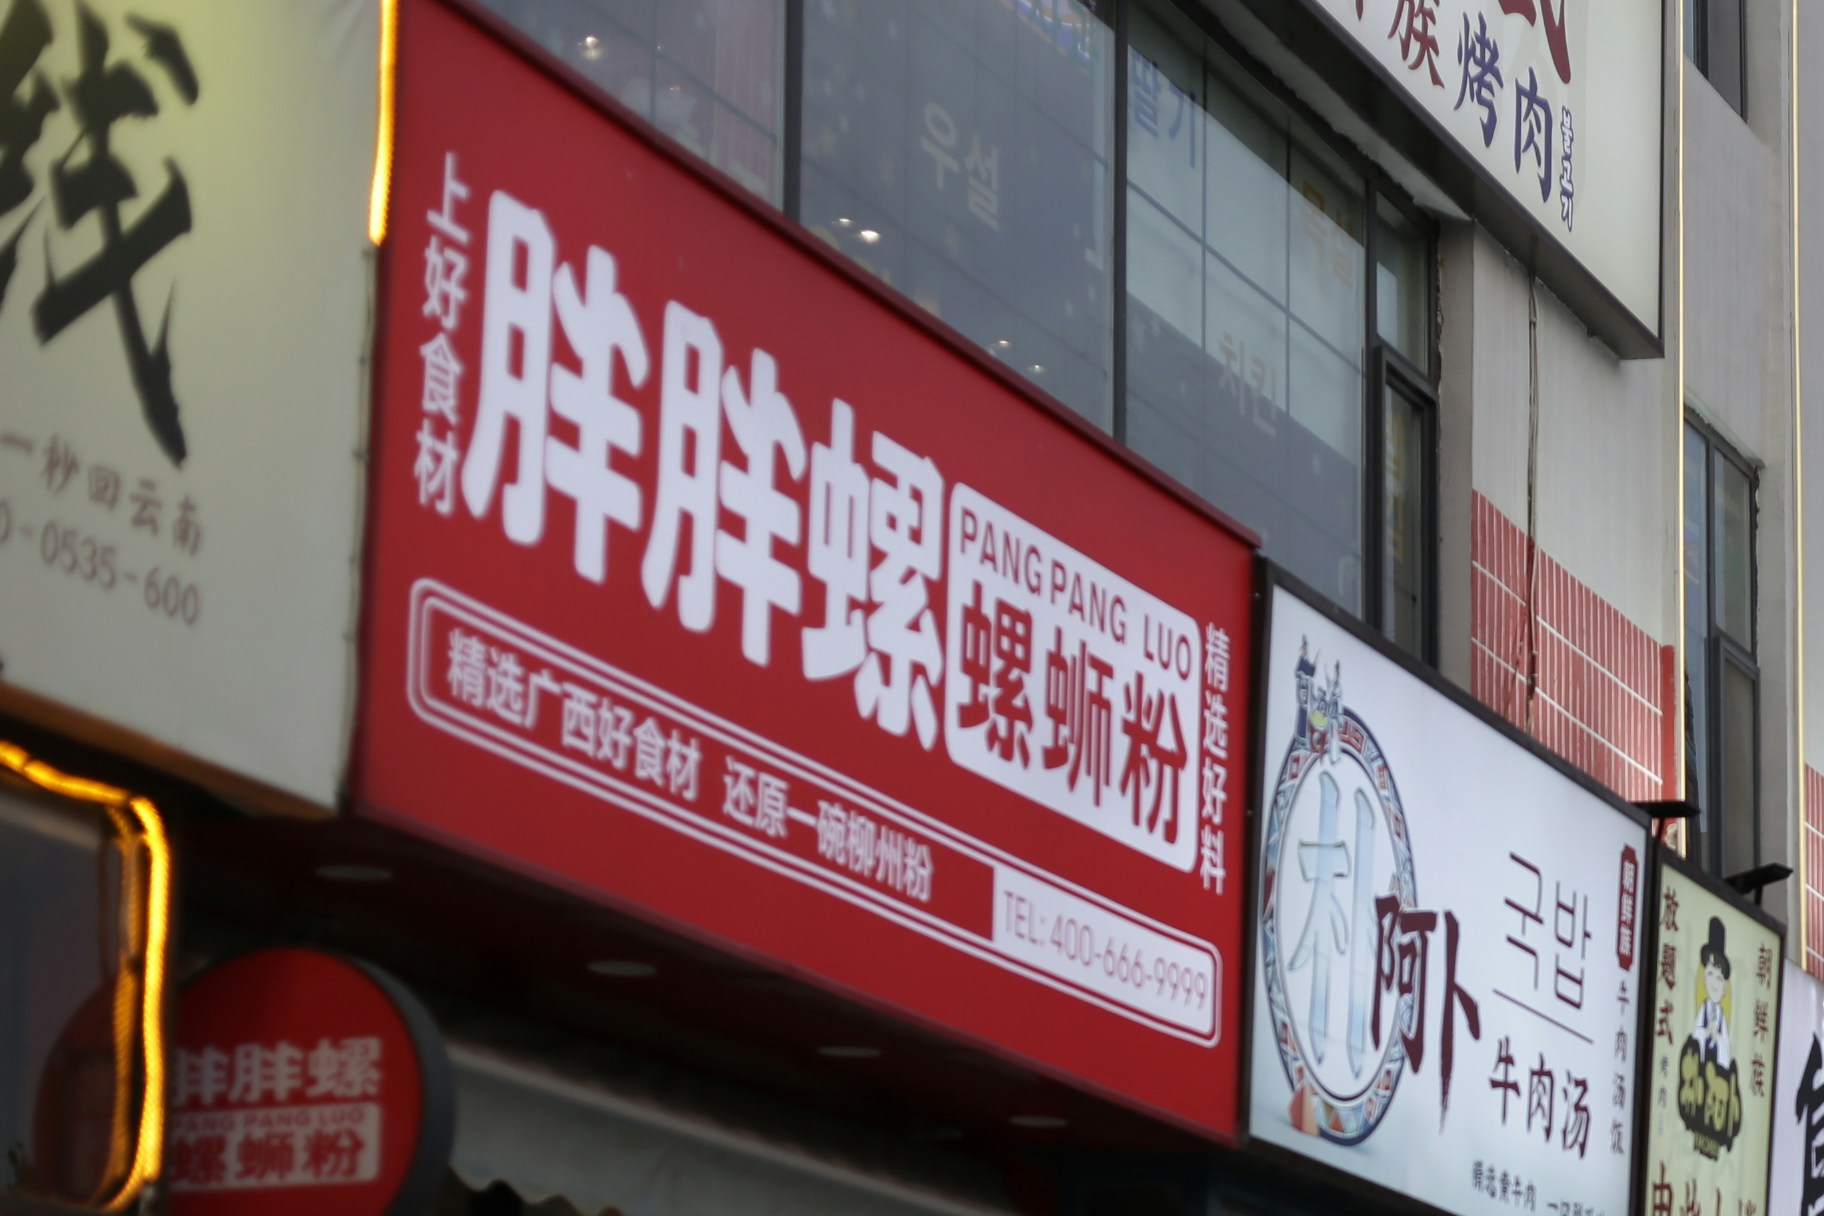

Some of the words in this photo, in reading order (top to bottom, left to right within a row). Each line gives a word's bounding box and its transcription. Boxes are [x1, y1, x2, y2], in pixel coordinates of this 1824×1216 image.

[920, 102, 1000, 231] 우설
[1560, 104, 1574, 233] 불고기
[414, 152, 471, 516] 上好食材
[461, 188, 945, 752] 胖胖螺
[960, 504, 1044, 598] PANG
[1051, 557, 1127, 646] PANG
[1143, 618, 1192, 684] LUO
[446, 628, 702, 800] 精选广西好食材
[722, 756, 933, 904] 还原一碗柳州粉
[957, 592, 1188, 846] 螺蛳粉
[1199, 622, 1231, 897] 精选好料
[1503, 850, 1594, 1012] 국밥
[1488, 1036, 1592, 1161] 牛肉汤
